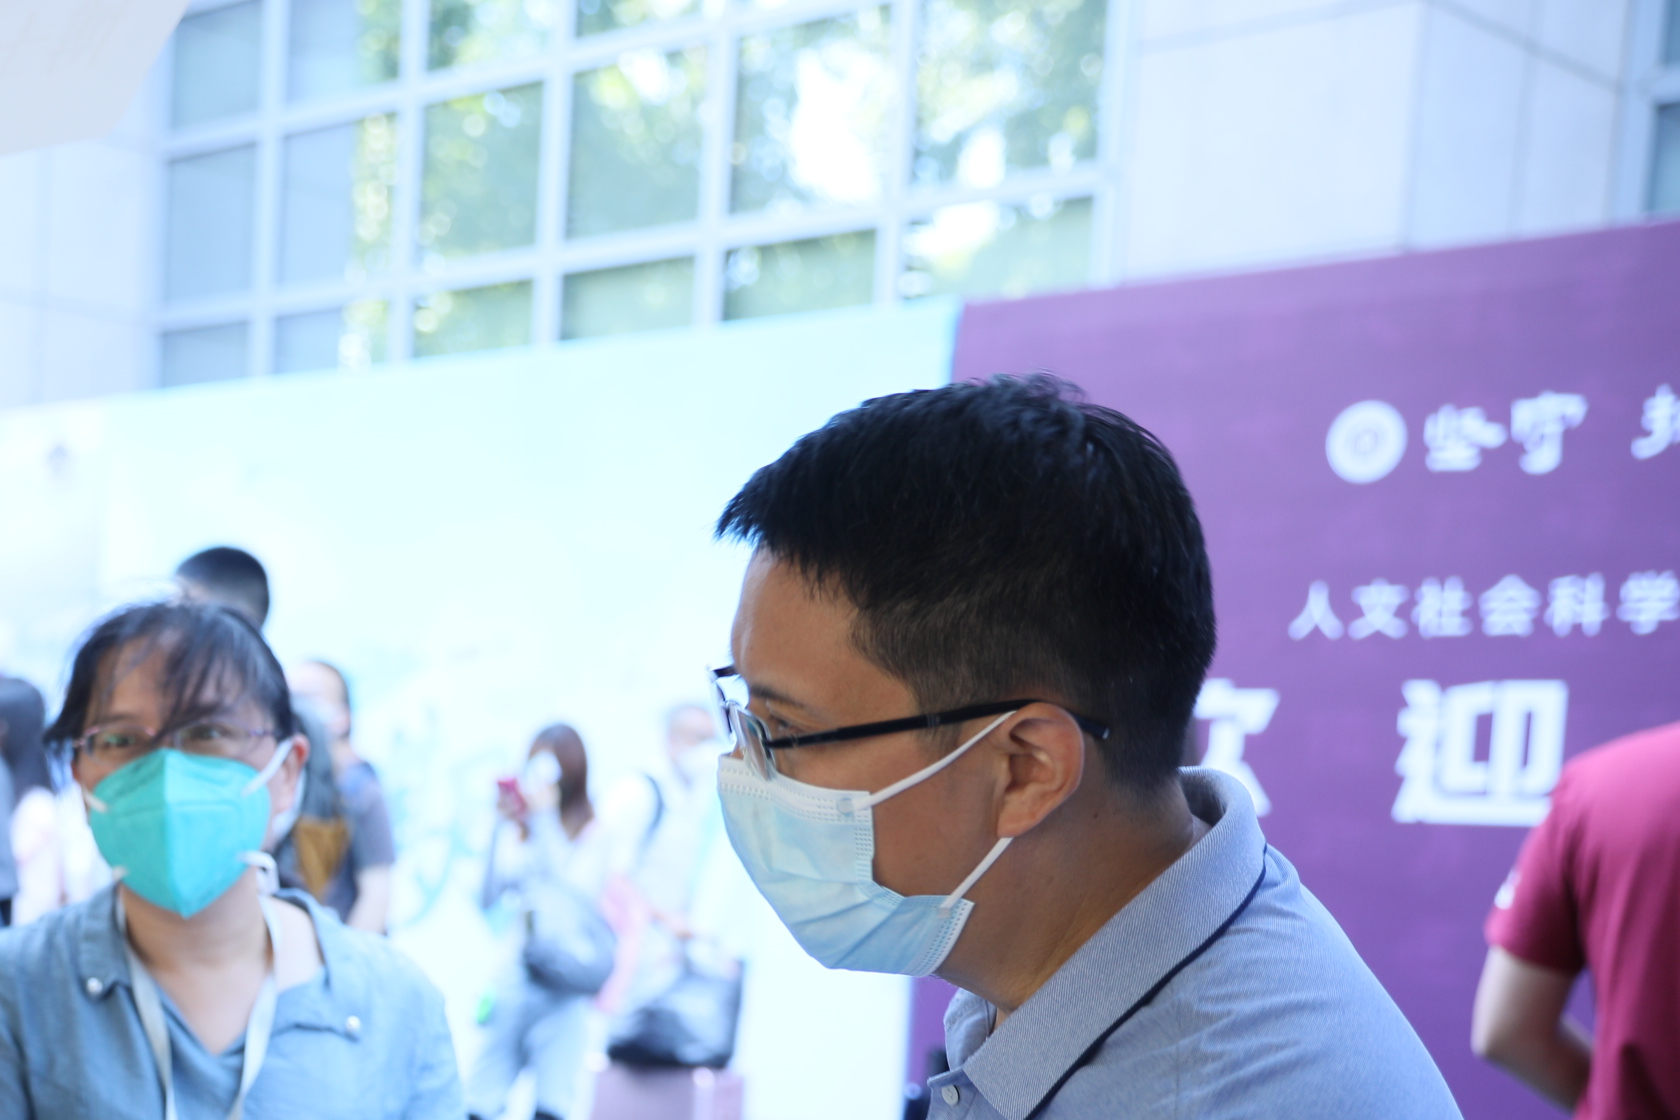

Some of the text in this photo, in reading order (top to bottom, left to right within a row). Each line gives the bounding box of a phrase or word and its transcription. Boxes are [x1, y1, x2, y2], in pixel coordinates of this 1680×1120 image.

[1287, 570, 1680, 640] 人文社会科学
